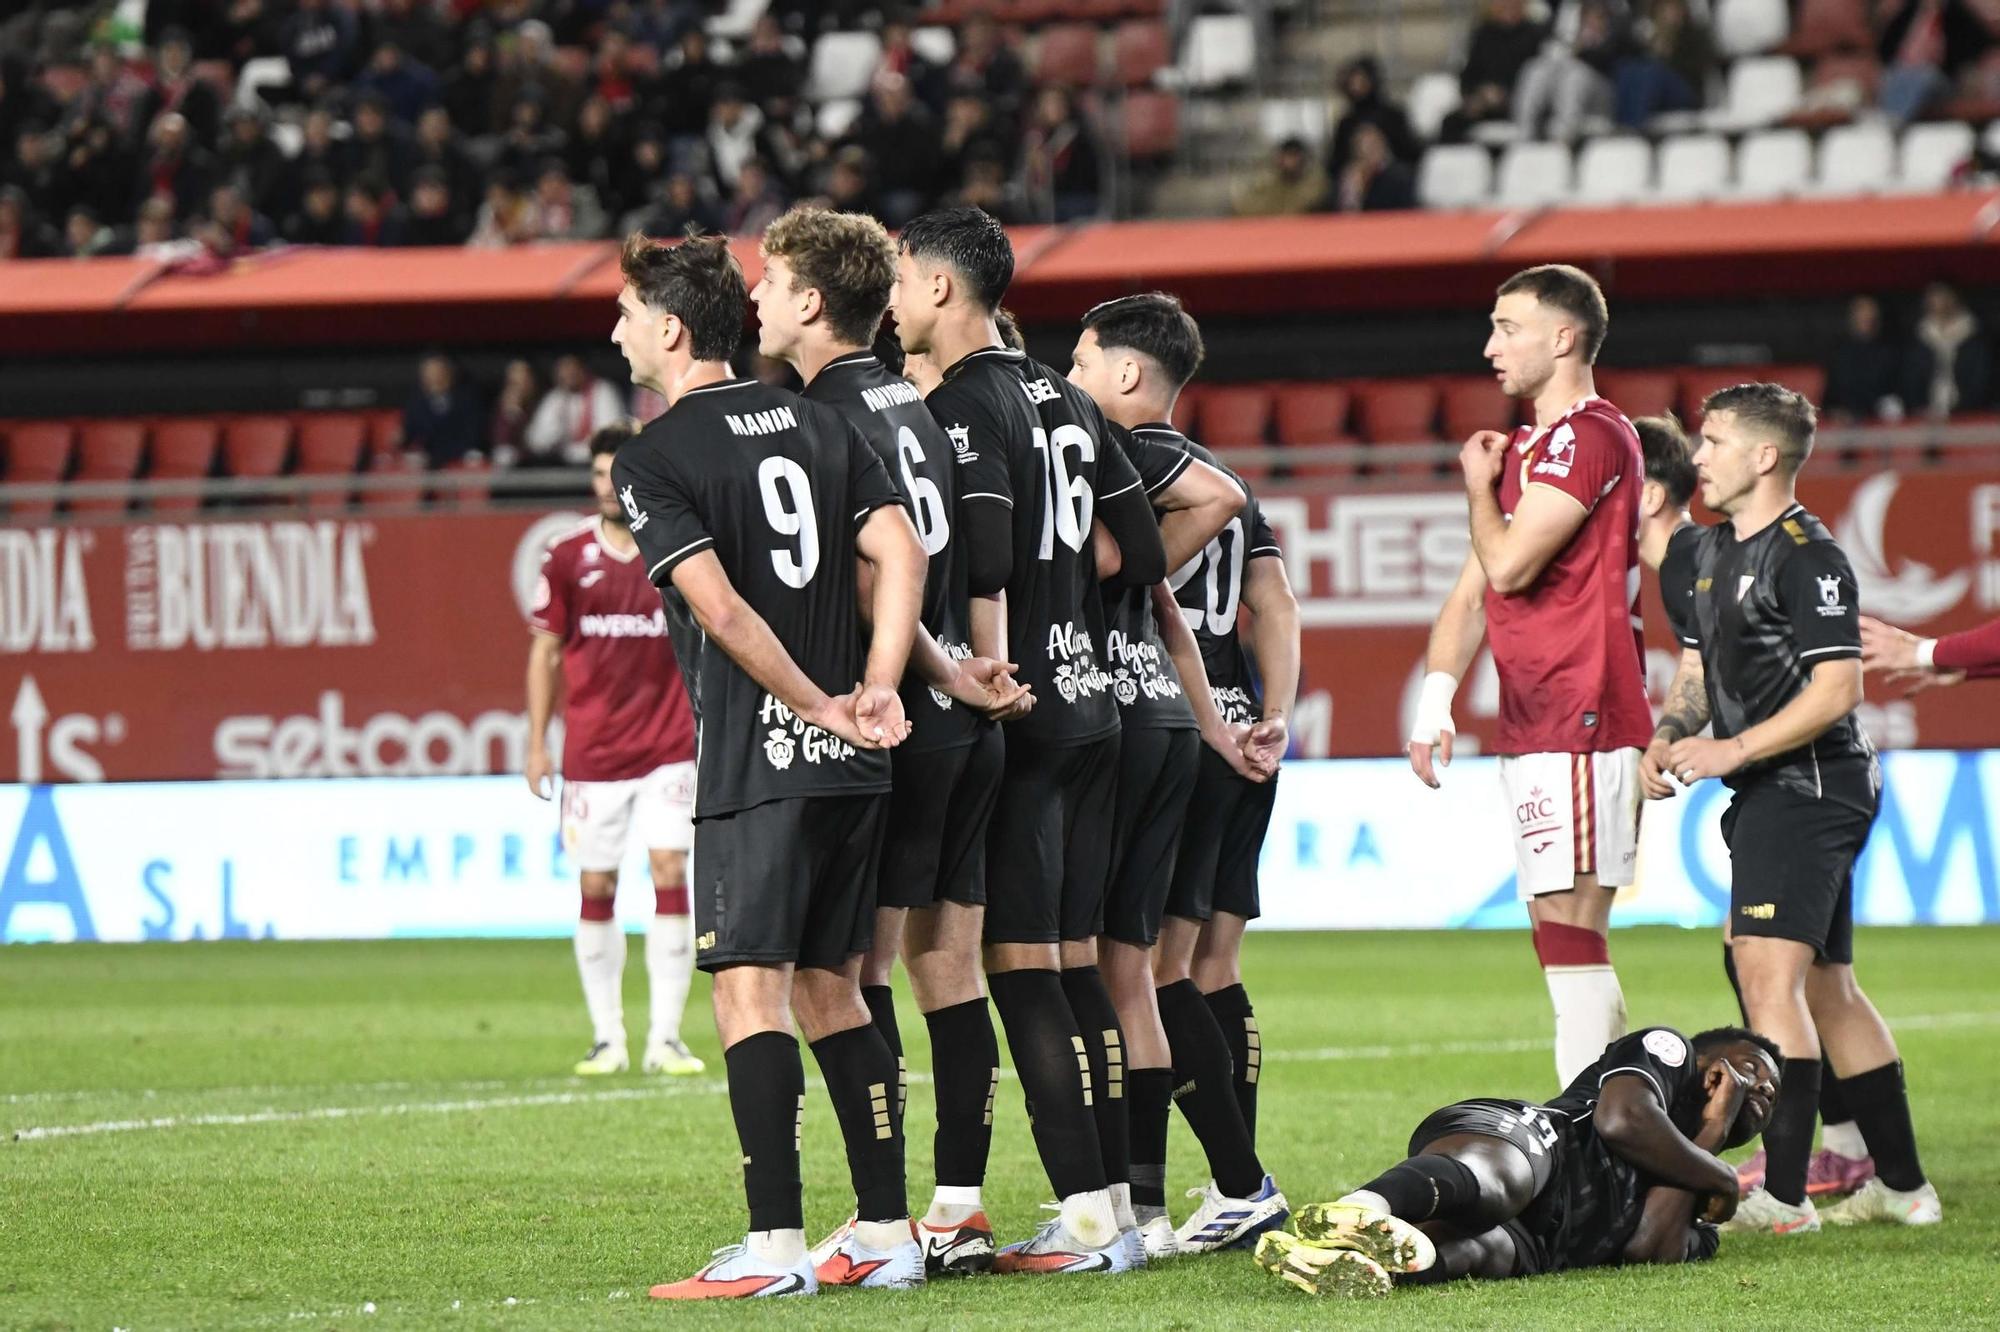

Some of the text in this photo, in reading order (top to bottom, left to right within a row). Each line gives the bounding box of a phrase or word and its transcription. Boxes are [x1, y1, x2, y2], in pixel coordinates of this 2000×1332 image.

[757, 455, 820, 589] 9
[896, 424, 951, 557] 6
[1032, 424, 1096, 561] 16
[0, 526, 94, 652] DIA
[155, 520, 377, 650] BUENDIA
[337, 833, 570, 886] EMPRE
[1295, 820, 1386, 870] RA
[1516, 797, 1556, 824] CRC
